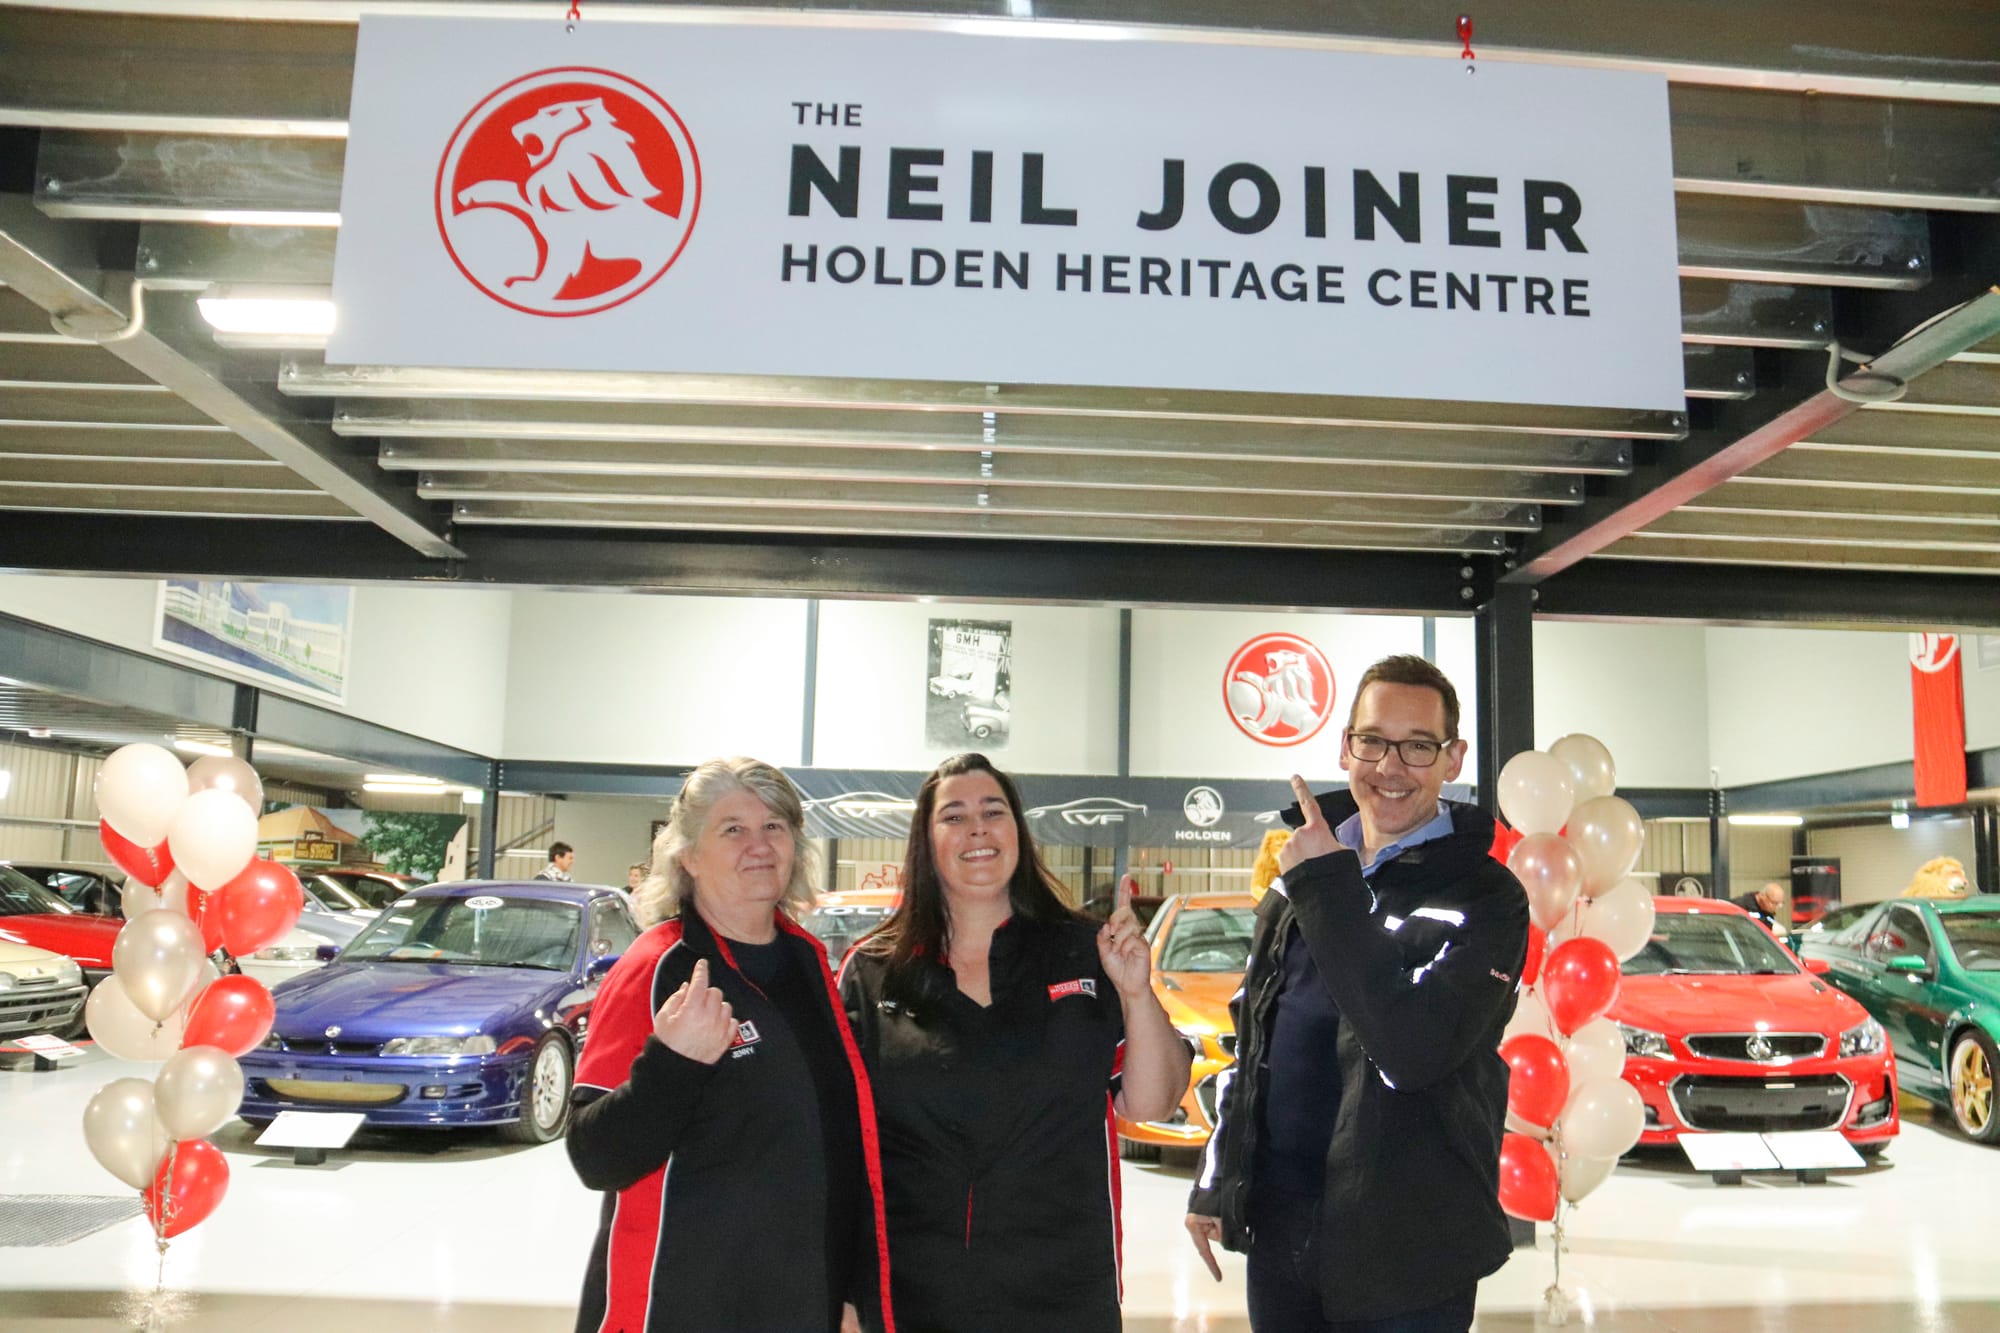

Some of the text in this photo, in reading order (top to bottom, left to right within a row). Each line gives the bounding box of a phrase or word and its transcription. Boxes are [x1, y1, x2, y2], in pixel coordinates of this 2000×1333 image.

[792, 102, 862, 127] THE
[788, 144, 1589, 257] NEIL JOINER
[781, 244, 1591, 317] HOLDEN HERITAGE CENTRE
[956, 633, 980, 647] GMH
[1074, 814, 1125, 826] VF
[1175, 830, 1232, 842] HOLDEN
